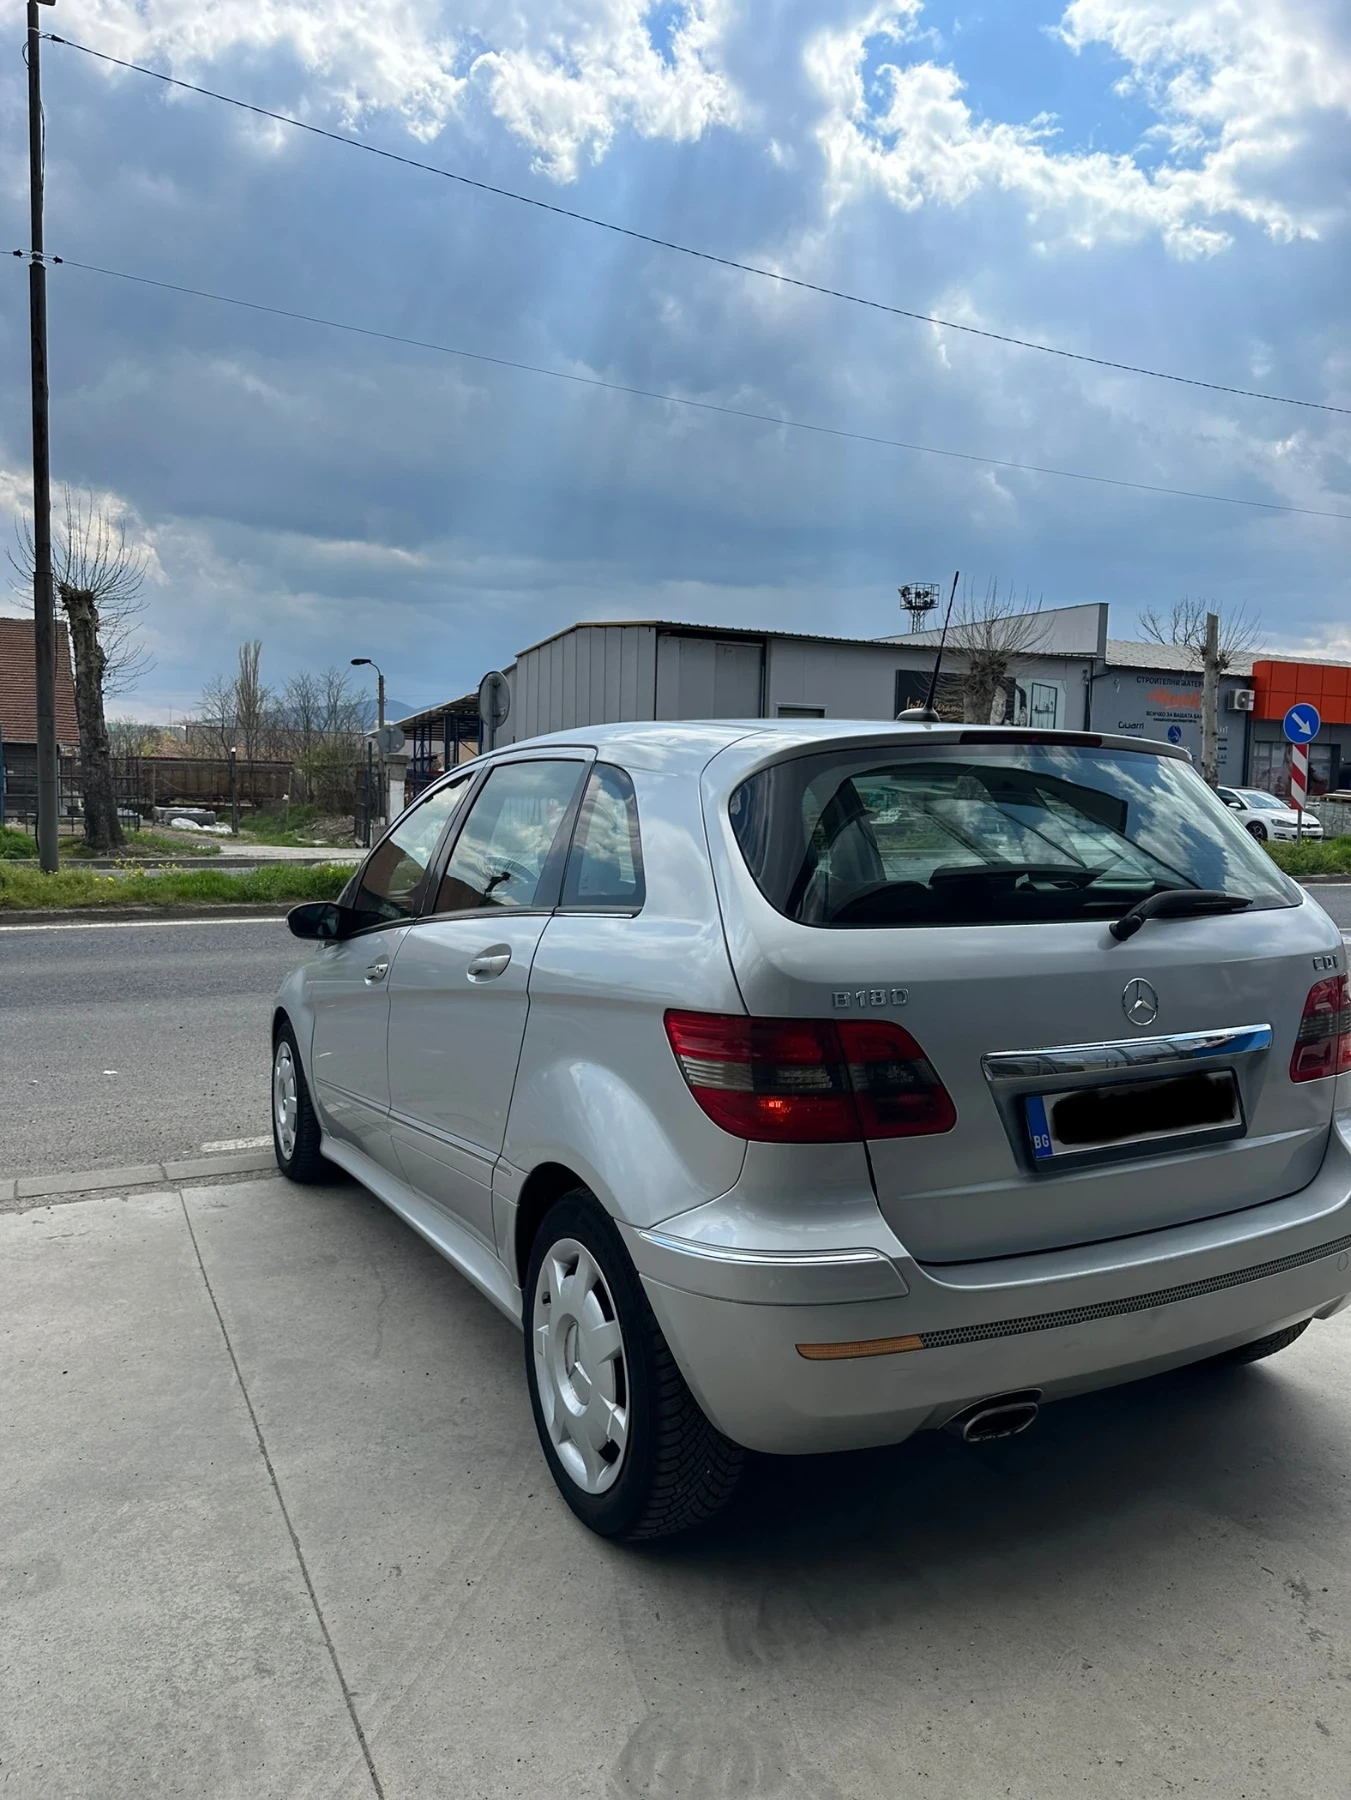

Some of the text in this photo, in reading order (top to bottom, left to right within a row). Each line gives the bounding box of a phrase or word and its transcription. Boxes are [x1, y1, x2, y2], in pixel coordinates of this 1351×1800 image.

[1136, 676, 1204, 688] СТРОИТЕЛНИ МАТЕР
[1312, 954, 1339, 971] CDI
[1033, 1133, 1050, 1149] BG
